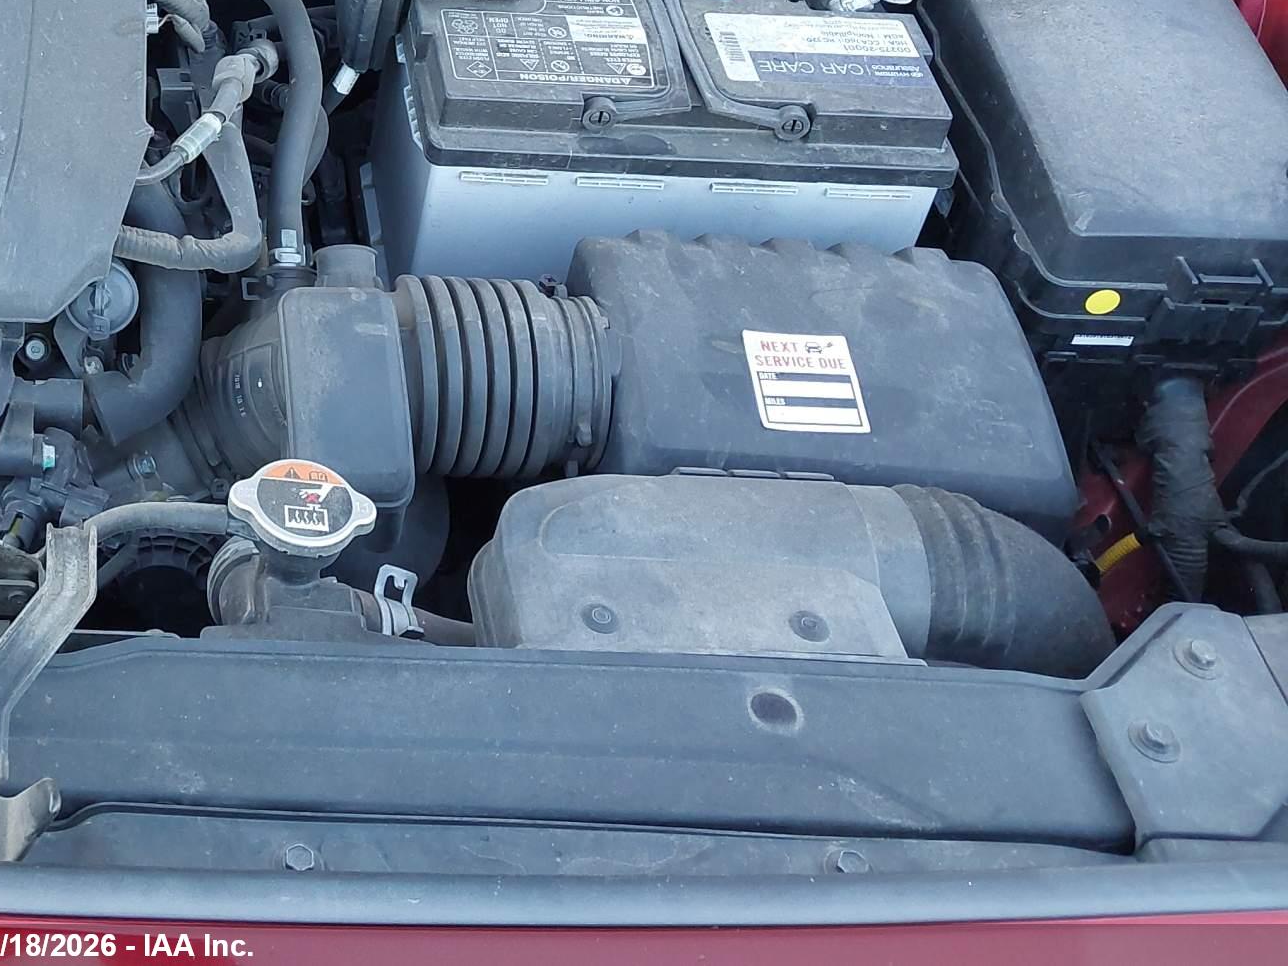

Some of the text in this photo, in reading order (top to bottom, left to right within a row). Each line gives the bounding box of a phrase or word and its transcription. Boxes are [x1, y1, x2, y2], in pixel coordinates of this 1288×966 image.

[757, 60, 864, 75] CAR CARE
[520, 74, 620, 83] DANGER/POISON
[760, 340, 799, 352] NEXT
[754, 355, 847, 369] SERVICE DUE
